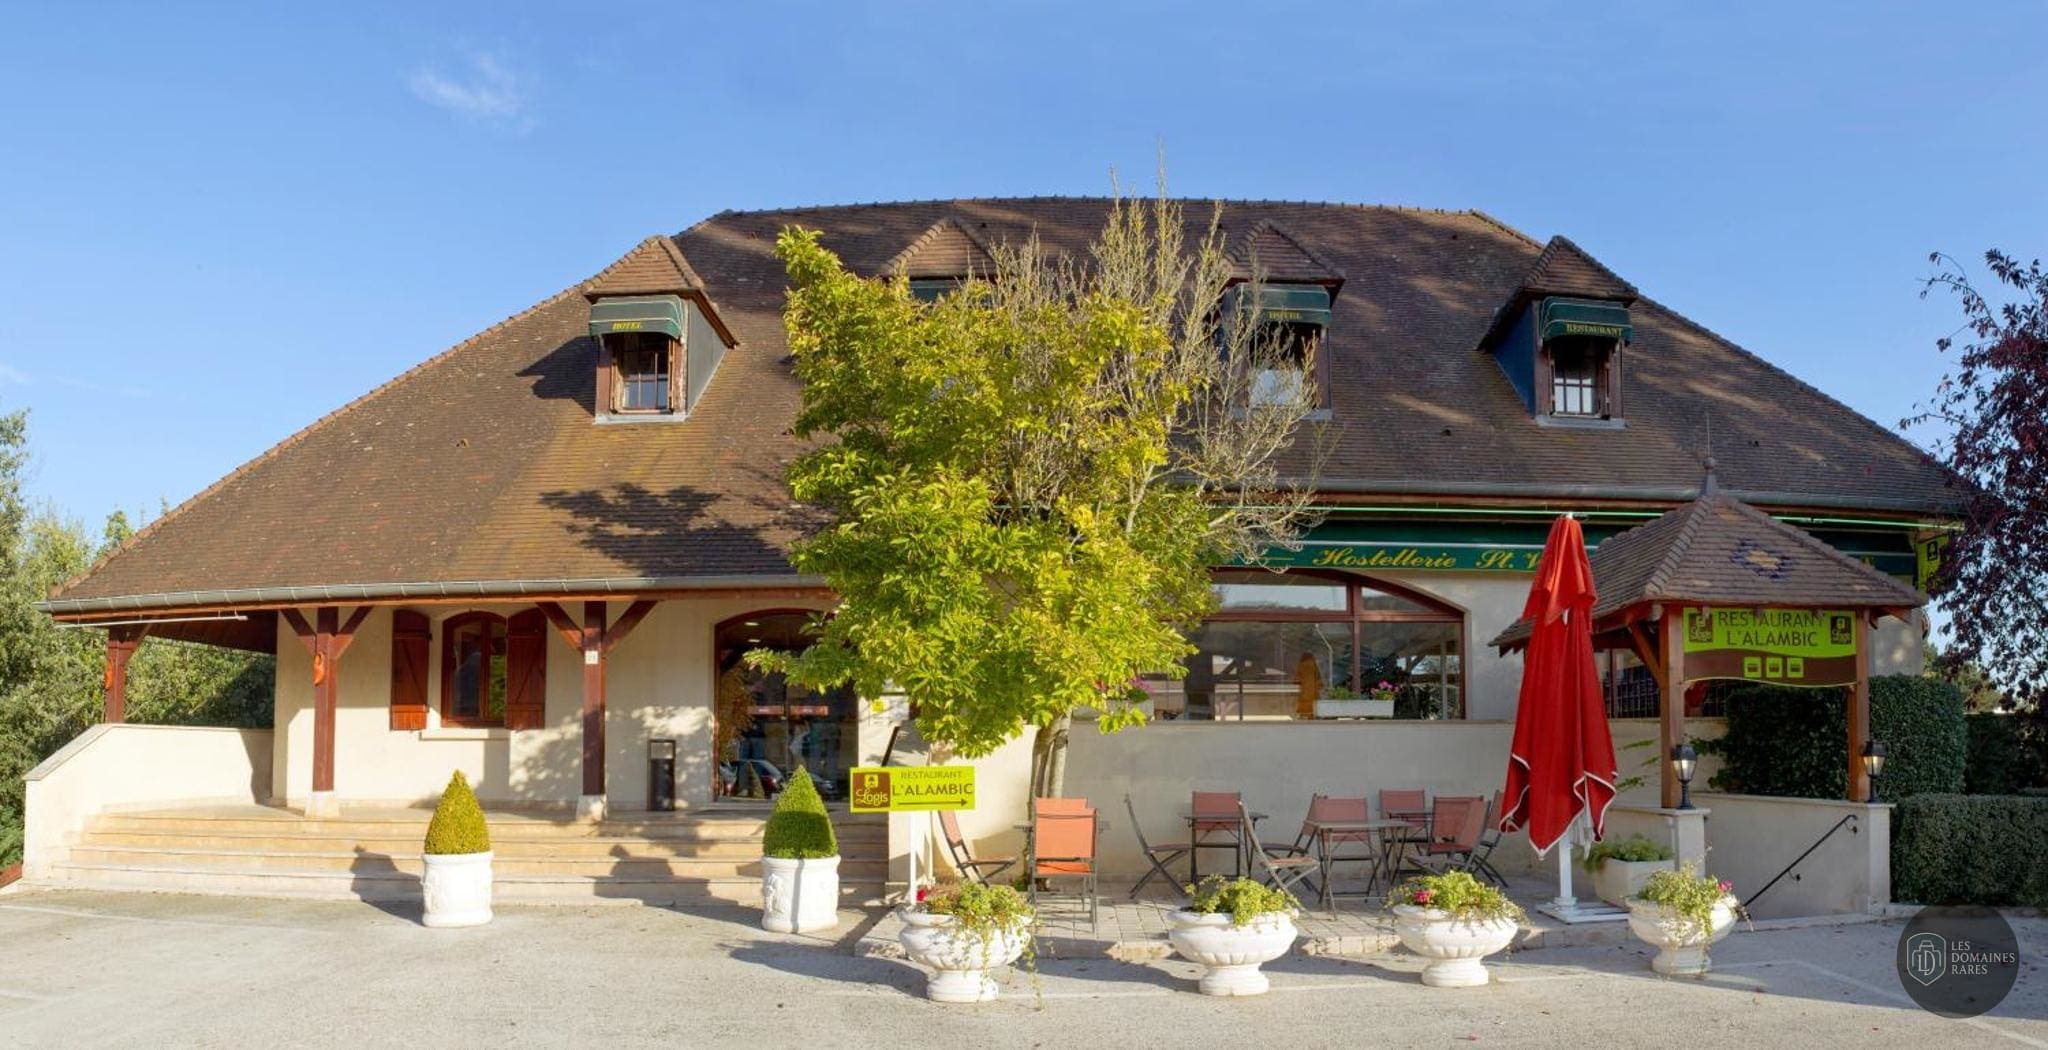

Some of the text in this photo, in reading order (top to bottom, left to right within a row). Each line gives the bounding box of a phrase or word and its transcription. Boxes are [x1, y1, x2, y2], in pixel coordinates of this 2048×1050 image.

[1565, 323, 1623, 336] RESTAURANT
[1313, 547, 1456, 568] Hostellerie
[1475, 549, 1515, 569] St.
[1727, 630, 1818, 647] L'ALAMBIC
[900, 770, 962, 780] RESTAURANT
[855, 787, 889, 807] Logis
[892, 783, 974, 796] L'ALAMBIC
